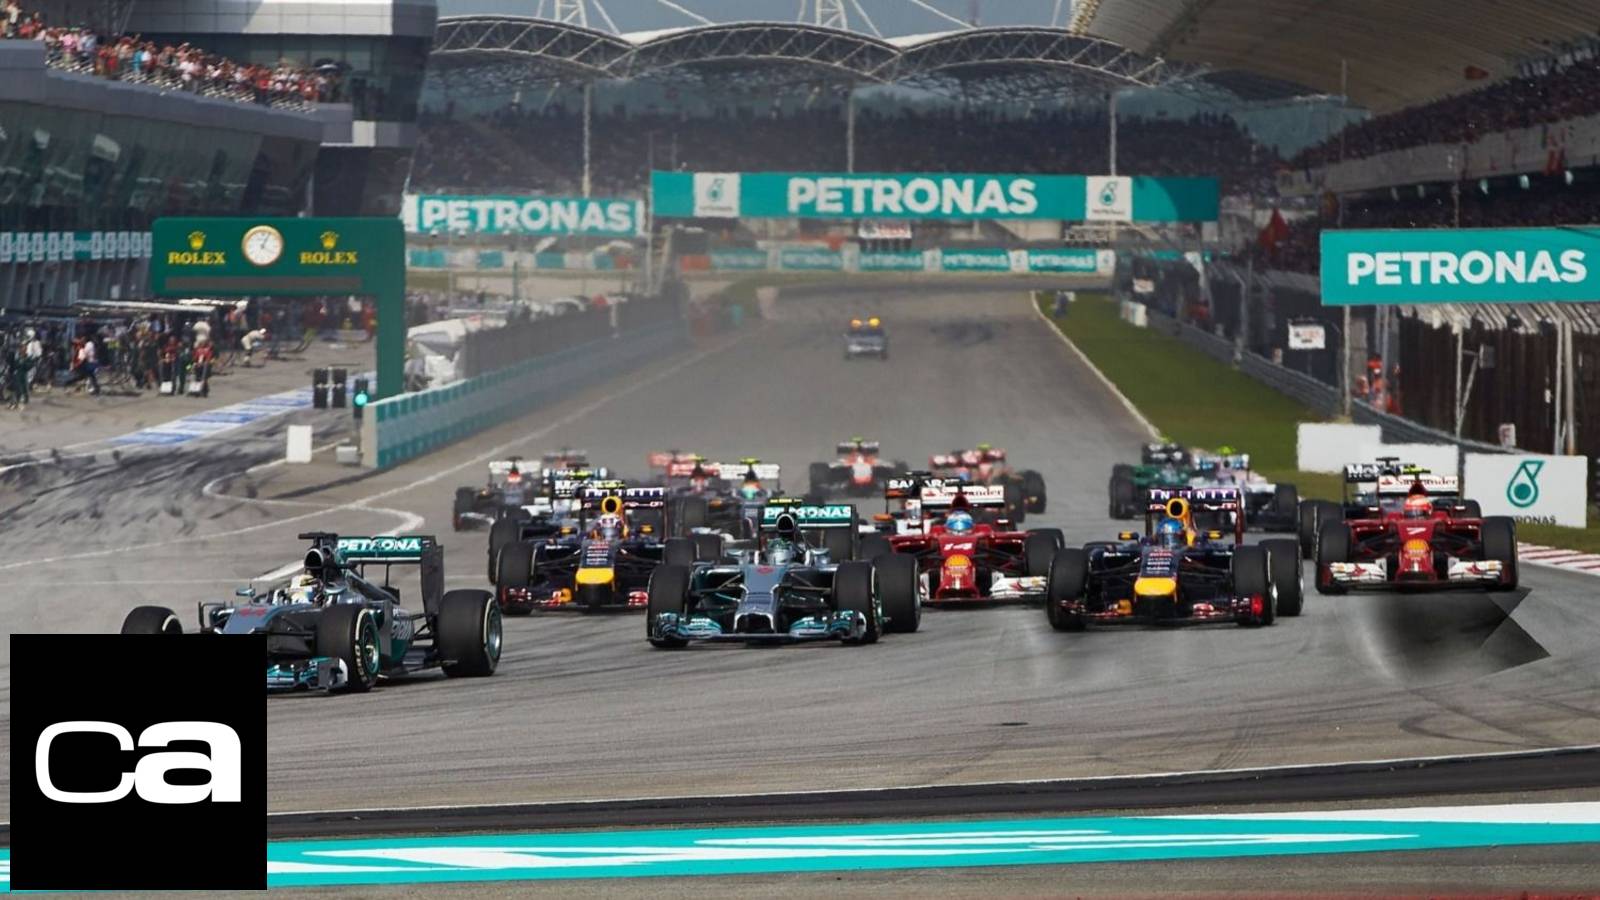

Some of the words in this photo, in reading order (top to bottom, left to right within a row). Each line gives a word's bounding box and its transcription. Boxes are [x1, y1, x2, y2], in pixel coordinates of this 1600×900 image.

[787, 178, 1037, 214] PETRONAS
[422, 199, 632, 233] PETRONAS
[168, 252, 226, 265] ROLEX
[300, 252, 357, 265] ROLEX
[1348, 250, 1587, 285] PETRONAS
